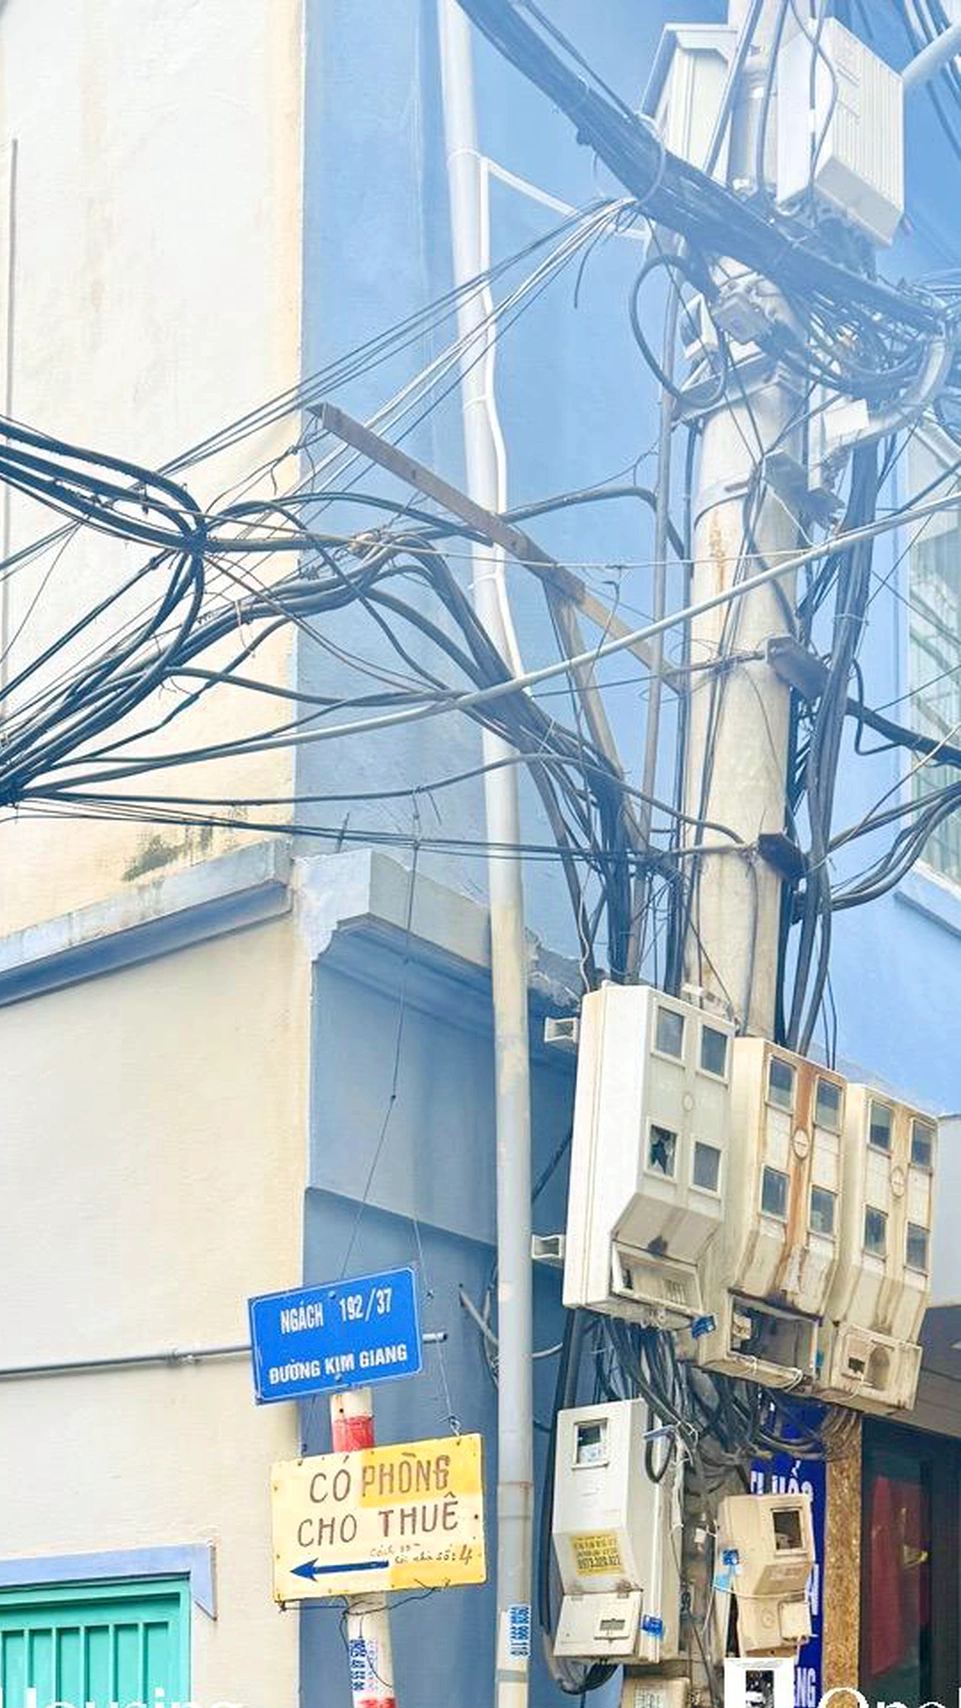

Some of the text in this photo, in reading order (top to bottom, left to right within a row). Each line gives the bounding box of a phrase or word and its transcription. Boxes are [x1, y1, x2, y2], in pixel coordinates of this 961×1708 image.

[280, 1288, 392, 1335] NGÁCH 192/37
[269, 1343, 407, 1385] ĐƯỜNG KIM GIANG
[309, 1452, 451, 1503] CÓ PHÒNG
[297, 1491, 459, 1547] CHO THUÊ
